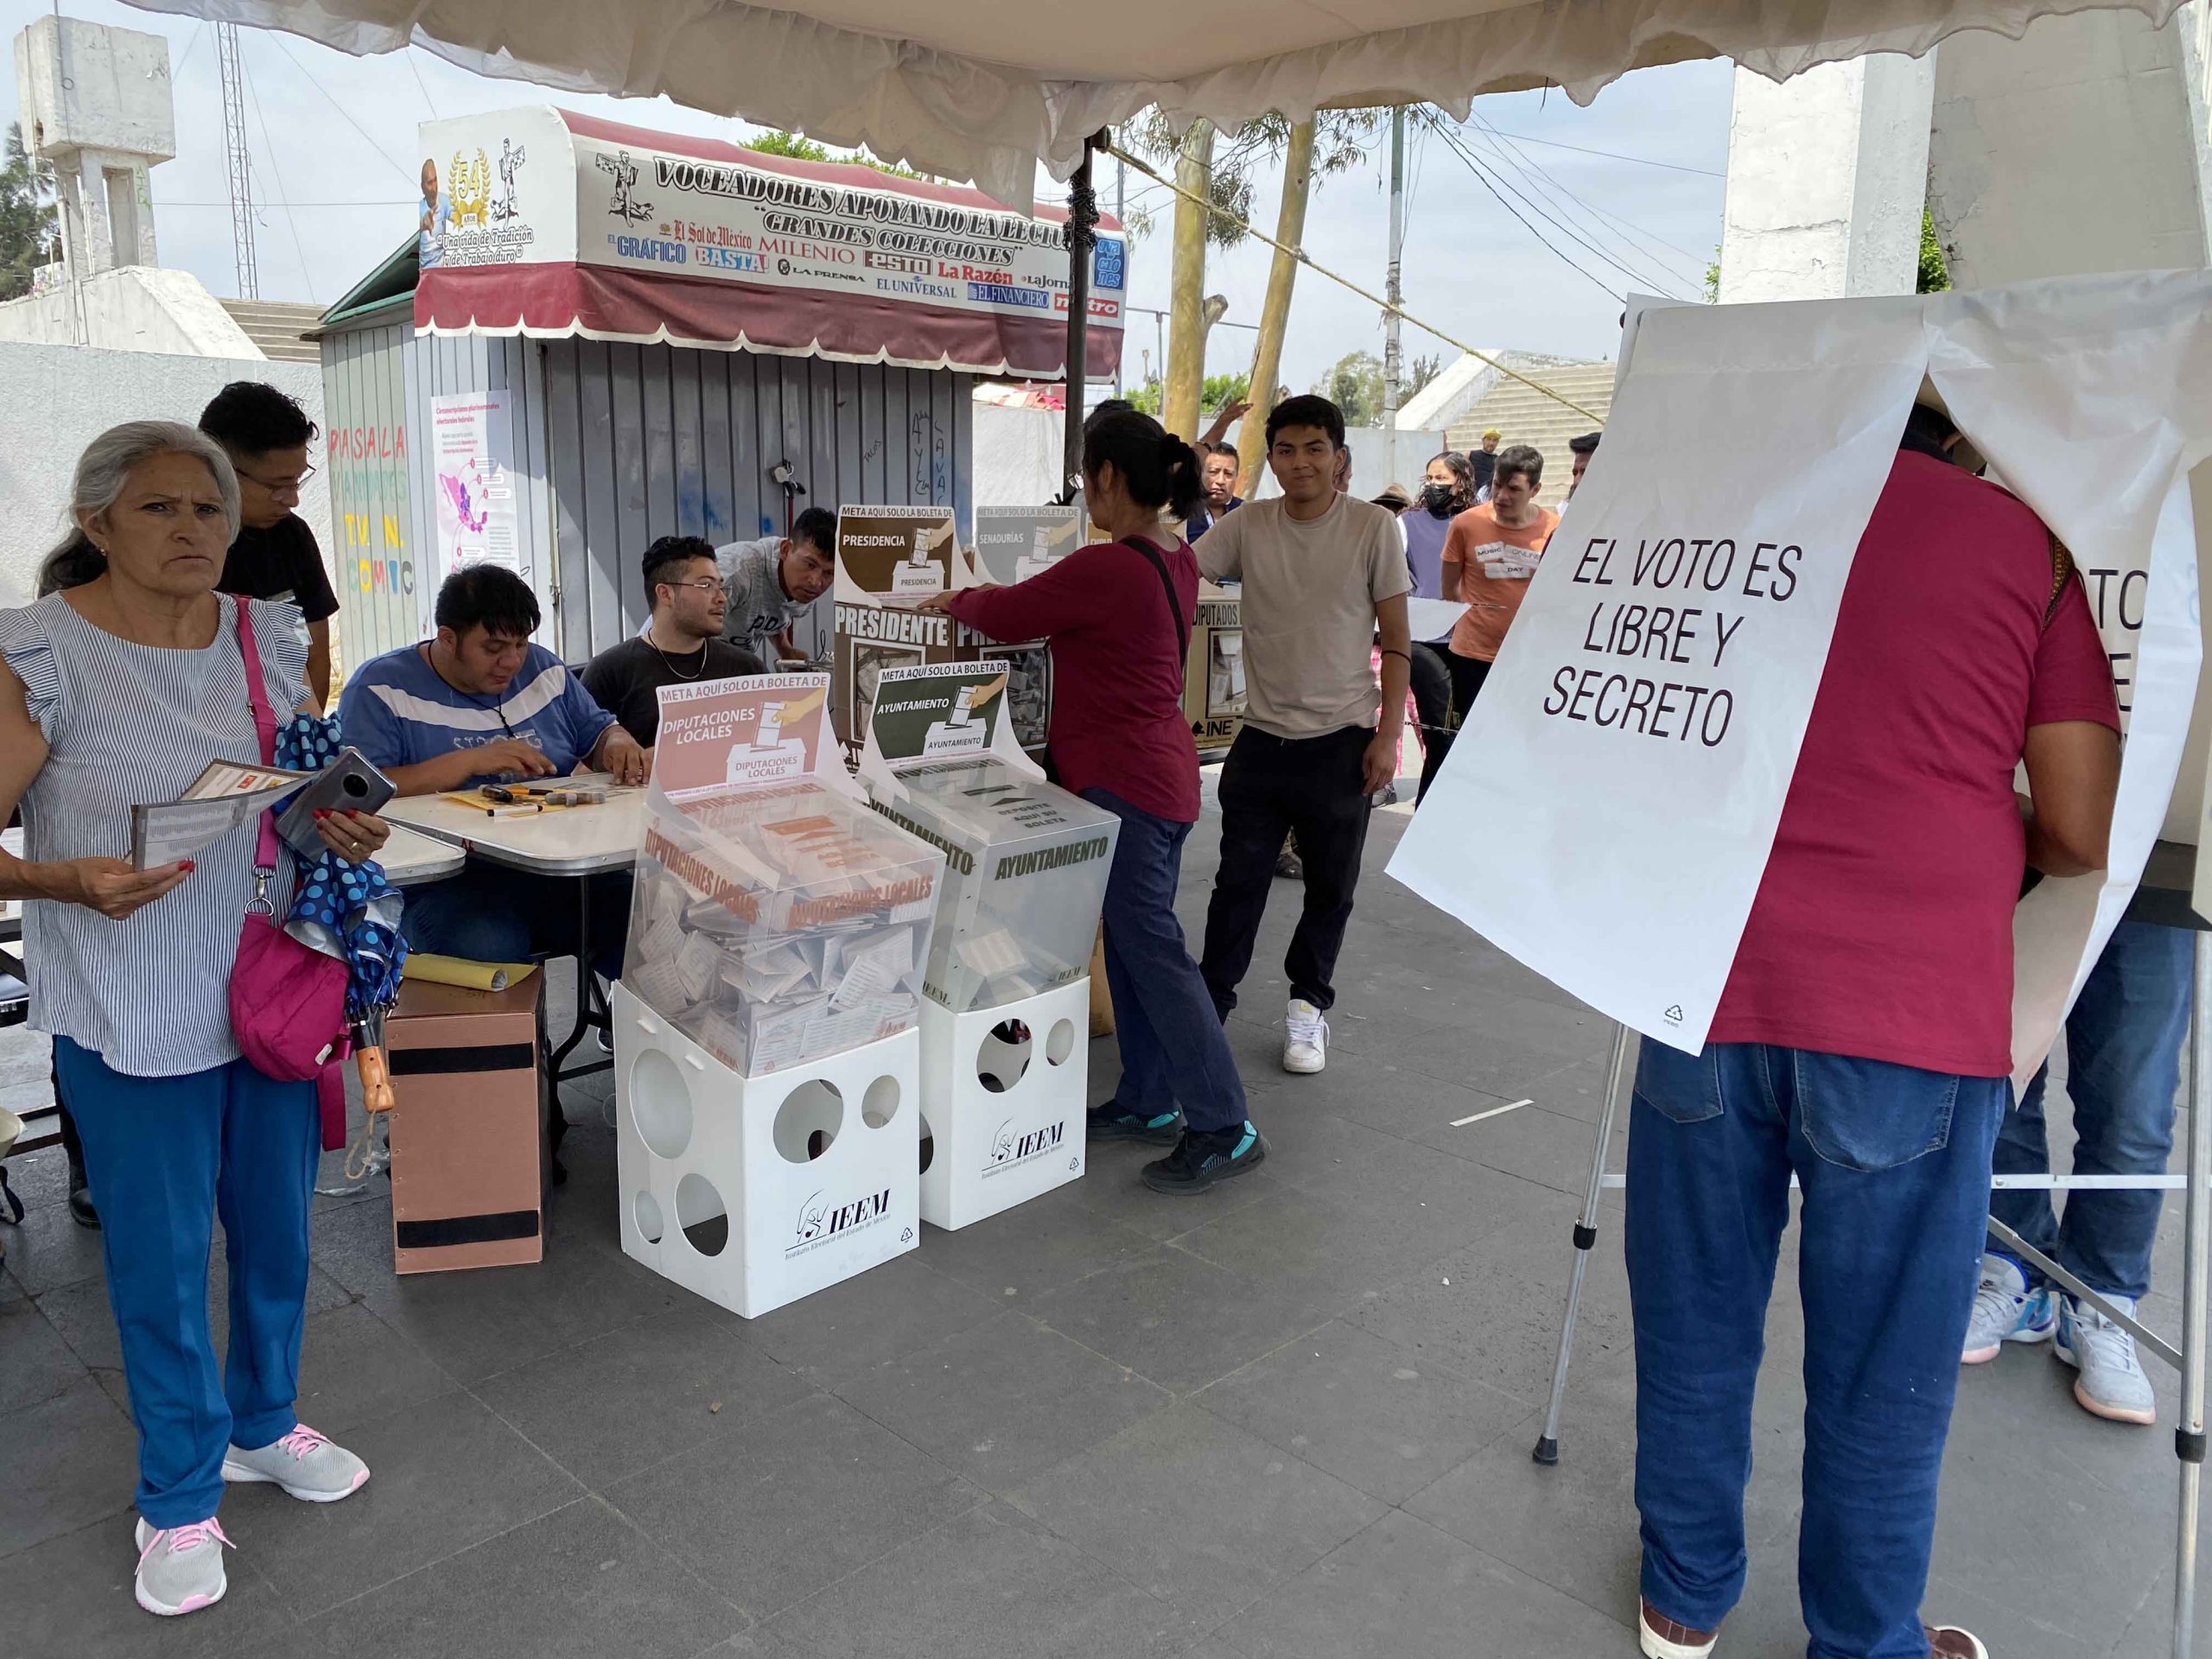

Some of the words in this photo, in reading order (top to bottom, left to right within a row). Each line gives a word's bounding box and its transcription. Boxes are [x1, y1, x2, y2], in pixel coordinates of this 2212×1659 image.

[458, 159, 480, 199] 54
[654, 157, 836, 212] VOCEADORES
[838, 191, 966, 232] APOYANDO
[967, 214, 997, 238] LA
[1001, 218, 1065, 250] LECTU
[463, 213, 476, 223] AÑOS
[461, 232, 478, 246] vida
[480, 230, 491, 245] de
[493, 226, 533, 244] Tradición
[674, 219, 685, 241] El
[688, 222, 705, 244] Sol
[707, 228, 716, 245] de
[717, 226, 752, 250] México
[451, 251, 461, 265] de
[463, 250, 493, 265] Trabajo
[607, 234, 616, 244] EL
[617, 235, 686, 264] GRÁFICO
[759, 236, 855, 264] MILENIO
[792, 267, 811, 276] LA
[814, 270, 866, 283] PRENSA
[938, 262, 959, 280] La
[962, 264, 1014, 286] Razón
[877, 277, 892, 290] EL
[893, 278, 957, 298] UNIVERSAL
[977, 285, 991, 301] EL
[992, 286, 1049, 308] FINANCIERO
[1056, 296, 1118, 314] mtro
[842, 506, 865, 517] META
[868, 506, 886, 517] AQUÍ
[887, 507, 906, 517] SOLO
[907, 508, 916, 517] LA
[917, 508, 942, 518] BOLETA
[944, 508, 953, 518] DE
[978, 508, 994, 517] META
[1008, 508, 1026, 517] SOLO
[1027, 508, 1035, 517] LA
[1037, 508, 1066, 517] BOLETA
[1068, 508, 1078, 517] DE
[842, 535, 906, 547] PRESIDENCIA
[979, 532, 1024, 544] SENADURÍAS
[1478, 547, 1502, 556] MUSIC
[348, 559, 414, 595] COMIC
[1573, 538, 1617, 585] EL
[1632, 538, 1735, 591] VOTO
[1742, 543, 1802, 601] ES
[900, 578, 937, 587] PRESIDENCIA
[2089, 569, 2149, 631] TO
[835, 605, 948, 647] PRESIDENTE
[1192, 604, 1237, 626] DIPUTADOS
[1583, 602, 1702, 664] LIBRE
[1713, 613, 1745, 667] Y
[882, 670, 905, 681] META
[906, 667, 926, 678] AQUÍ
[928, 665, 950, 676] SOLO
[952, 664, 963, 674] LA
[964, 663, 995, 673] BOLETA
[997, 662, 1007, 671] DE
[661, 688, 693, 702] META
[696, 681, 721, 697] AQUÍ
[722, 680, 749, 693] SOLO
[752, 678, 765, 690] LA
[767, 677, 810, 688] BOLETA
[812, 677, 827, 686] DE
[877, 698, 949, 715] AYUNTAMIENTO
[1543, 665, 1733, 747] SECRETO
[664, 708, 755, 734] DIPUTACIONES
[1206, 720, 1234, 737] INE
[677, 724, 733, 745] LOCALES
[928, 737, 982, 749] AYUNTAMIENTO
[735, 756, 798, 771] DIPUTACIONES
[748, 766, 785, 778] LOCALES
[1023, 817, 1068, 829] BOLETA
[995, 836, 1109, 881] AYUNTAMIENTO
[885, 874, 934, 906] LOCALES
[1016, 1121, 1065, 1159] IEEM
[828, 1188, 891, 1236] IEEM
[785, 1247, 810, 1261] Instituto
[810, 1237, 836, 1252] Electoral
[836, 1233, 846, 1242] del
[846, 1225, 864, 1237] Estado
[865, 1221, 873, 1230] de
